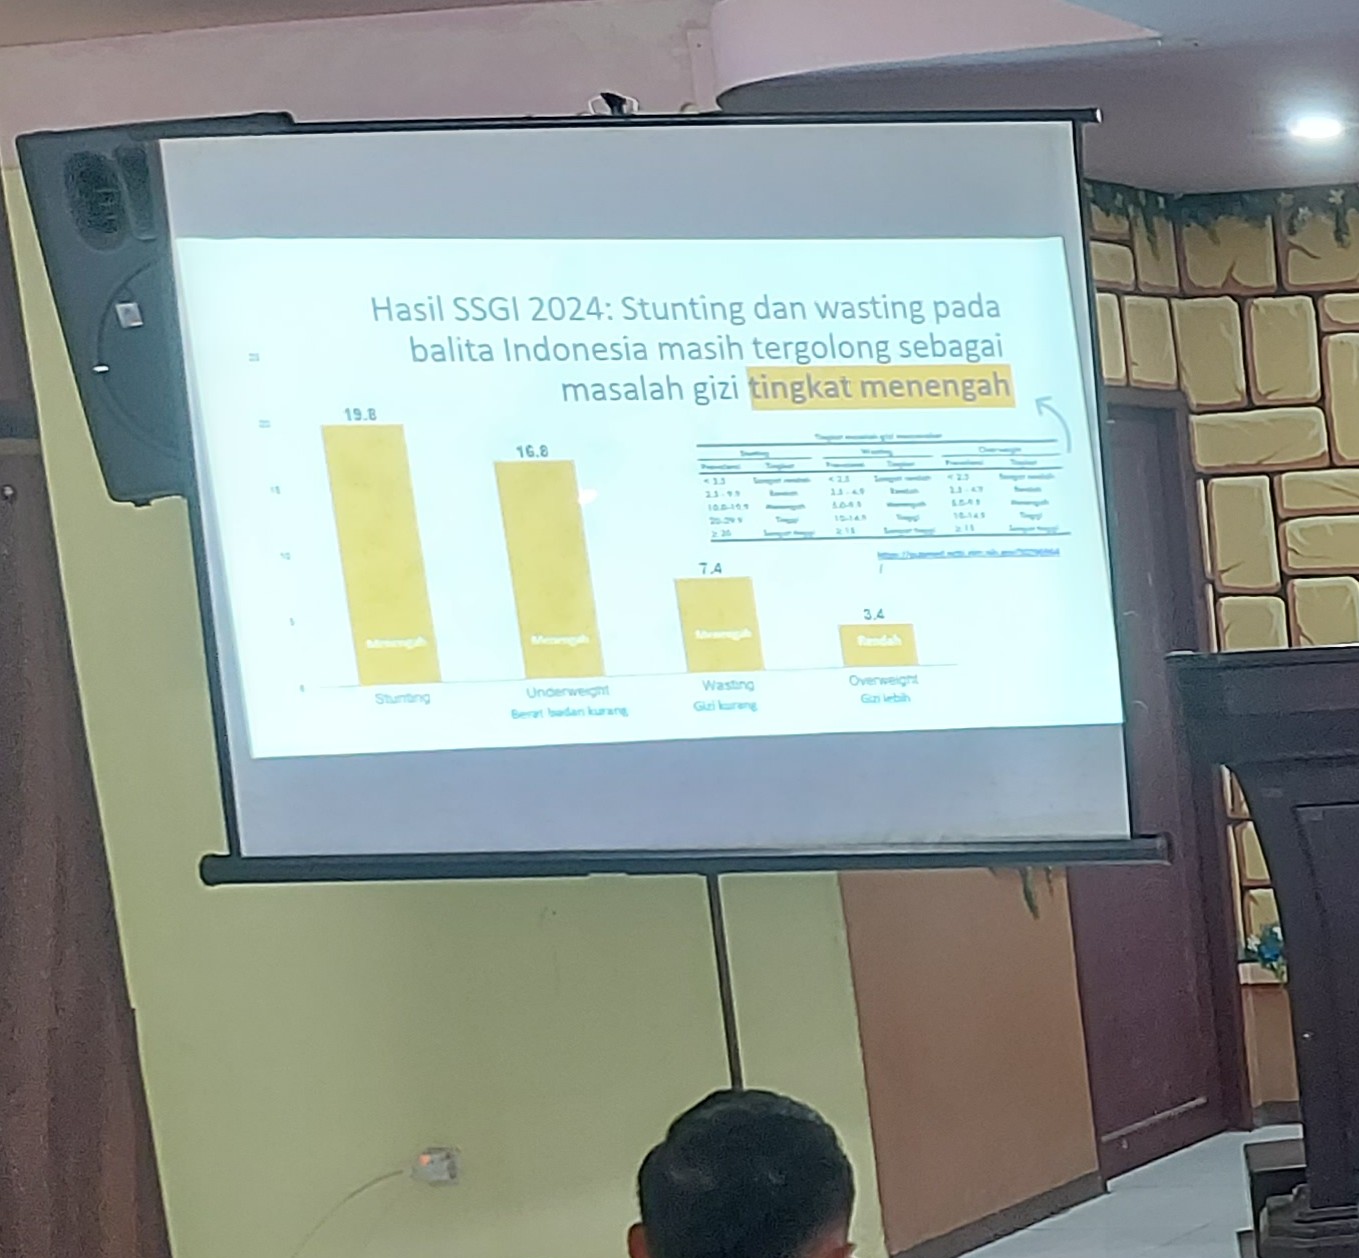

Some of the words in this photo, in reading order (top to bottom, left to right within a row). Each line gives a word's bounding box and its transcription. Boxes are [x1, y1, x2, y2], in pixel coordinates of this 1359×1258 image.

[371, 295, 444, 322] Hasil
[453, 296, 519, 321] SSGI
[528, 296, 613, 321] 2024:
[621, 295, 746, 326] Stunting
[753, 294, 806, 320] dan
[815, 294, 925, 325] wasting
[933, 292, 1001, 324] pada
[410, 336, 494, 362] balita
[503, 335, 648, 361] Indonesia
[658, 334, 743, 360] masih
[752, 333, 891, 364] tergolong
[899, 332, 1003, 363] sebagai
[562, 374, 684, 402] masalah
[693, 375, 739, 405] gizi
[748, 373, 852, 404] tingkat
[860, 371, 1011, 401] menengah
[863, 608, 885, 621] 3.4
[702, 679, 755, 693] Wasting
